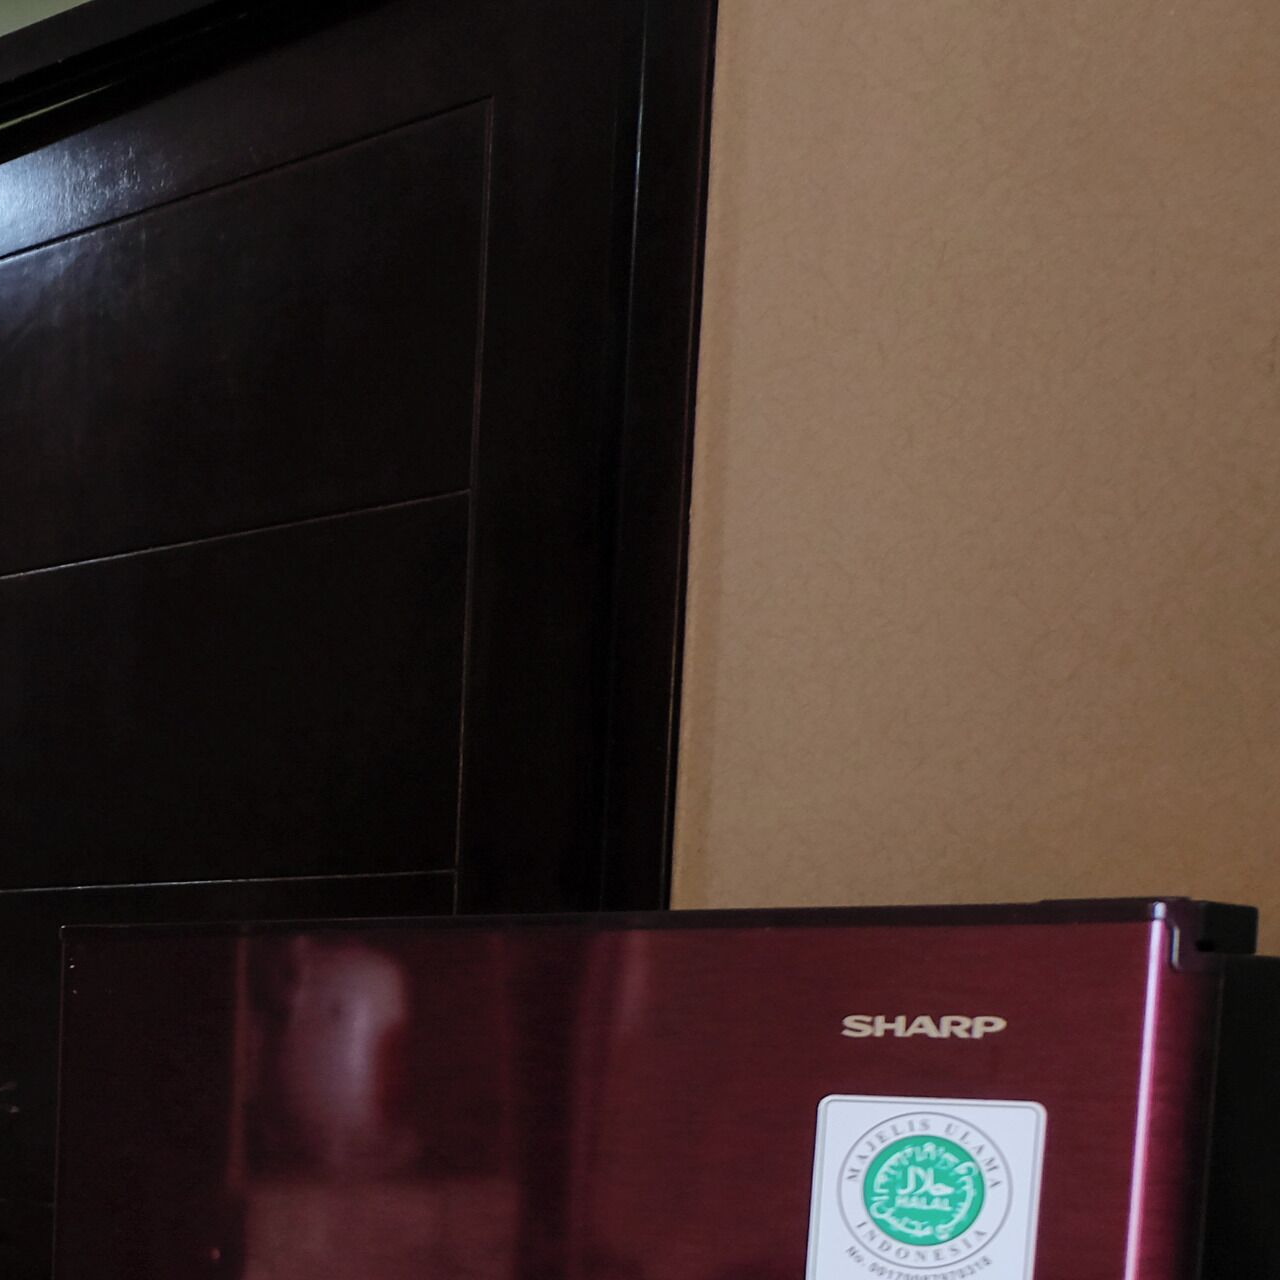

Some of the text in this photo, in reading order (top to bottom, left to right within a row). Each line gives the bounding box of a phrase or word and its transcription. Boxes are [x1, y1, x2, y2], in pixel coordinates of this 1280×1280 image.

[841, 1014, 1008, 1039] SHARP
[846, 1119, 1003, 1189] MAJELIS ULAMA
[895, 1196, 952, 1211] HALAL
[855, 1220, 988, 1262] INDONESIA
